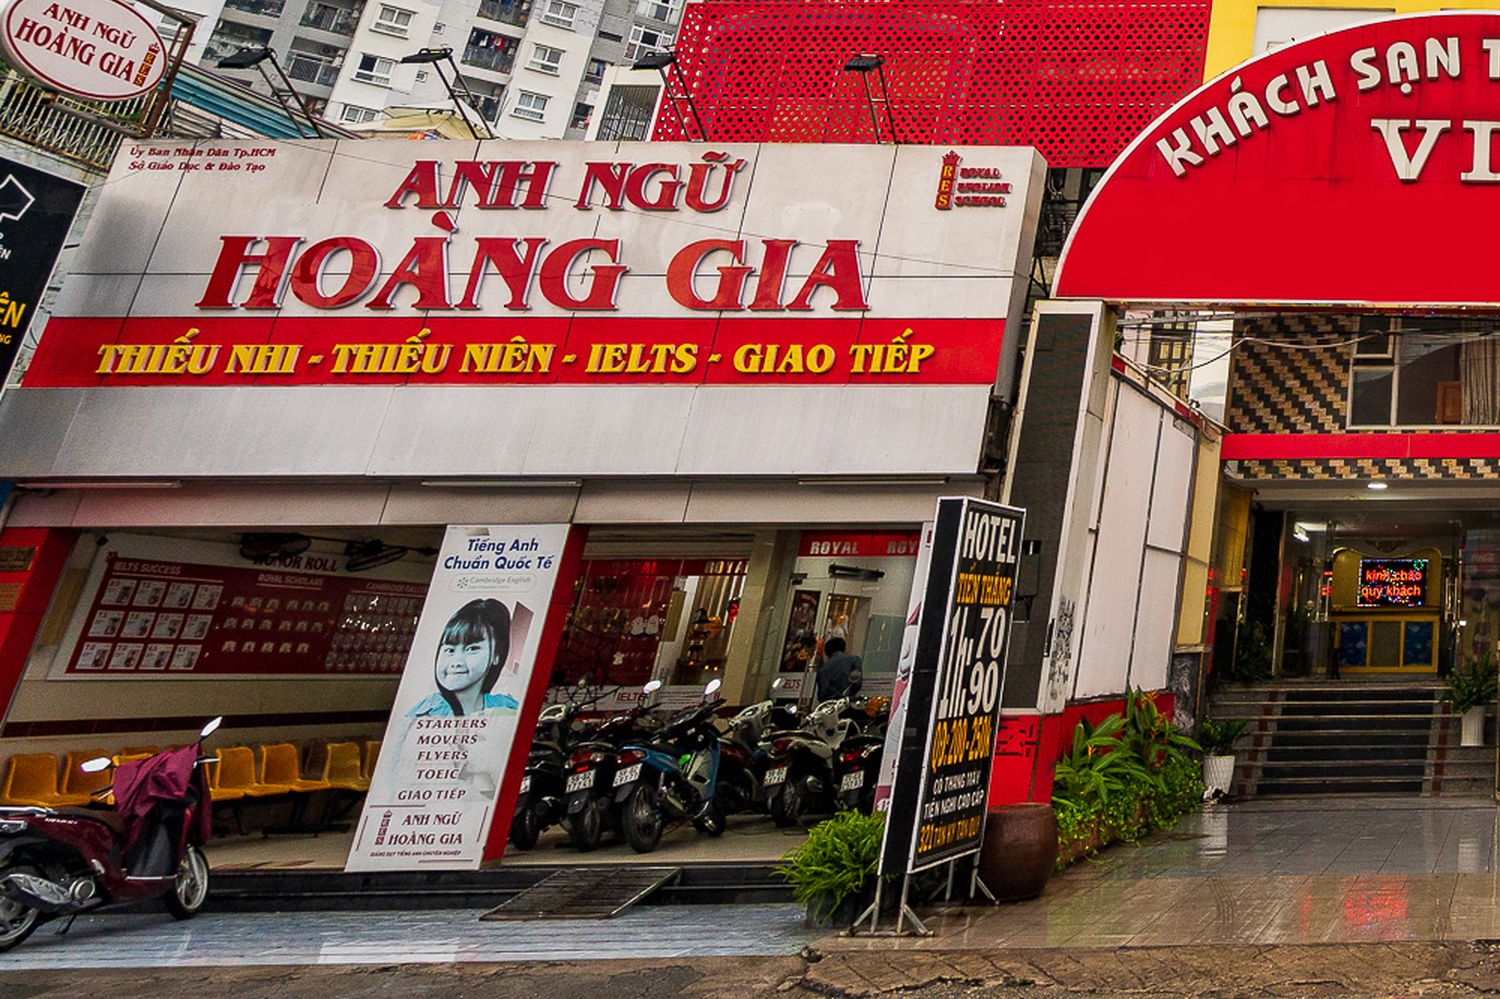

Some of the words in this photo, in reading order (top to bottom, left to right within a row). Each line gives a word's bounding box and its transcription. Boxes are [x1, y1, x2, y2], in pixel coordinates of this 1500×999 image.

[43, 3, 90, 31] ANH
[92, 21, 137, 49] NGỮ
[14, 17, 96, 66] HOÀNG
[99, 52, 135, 82] GIA
[1155, 58, 1337, 177] KHÁCH
[1349, 36, 1461, 96] SẠN
[383, 160, 560, 211] ANH
[573, 150, 747, 214] NGỮ
[195, 210, 630, 311] HOÀNG
[666, 238, 871, 311] GIA
[96, 328, 221, 375] THIẾU
[224, 343, 303, 375] NHI
[331, 328, 453, 375] THIẾU
[459, 336, 556, 374] NIÊN
[585, 343, 698, 374] IELTS
[733, 343, 836, 375] GIAO
[849, 327, 936, 374] TIẾP
[468, 537, 505, 555] Tiếng
[509, 537, 538, 552] Anh
[810, 540, 859, 555] ROYAL
[962, 511, 1016, 564] HOTEL
[444, 555, 489, 569] Chuẩn
[494, 555, 532, 570] Quốc
[536, 555, 554, 569] Tế
[956, 562, 981, 604] TIẾN
[976, 607, 1006, 659] 70
[967, 661, 999, 715] 90
[416, 719, 488, 730] STARTERS
[416, 734, 478, 745] MOVERS
[417, 751, 469, 761] FLYERS
[416, 769, 460, 779] TOEIC
[398, 790, 432, 800] GIAO
[436, 787, 466, 800] TIẾP
[402, 814, 430, 826] ANH
[432, 811, 463, 826] NGỮ
[388, 831, 435, 845] HOÀNG
[439, 833, 463, 845] GIA
